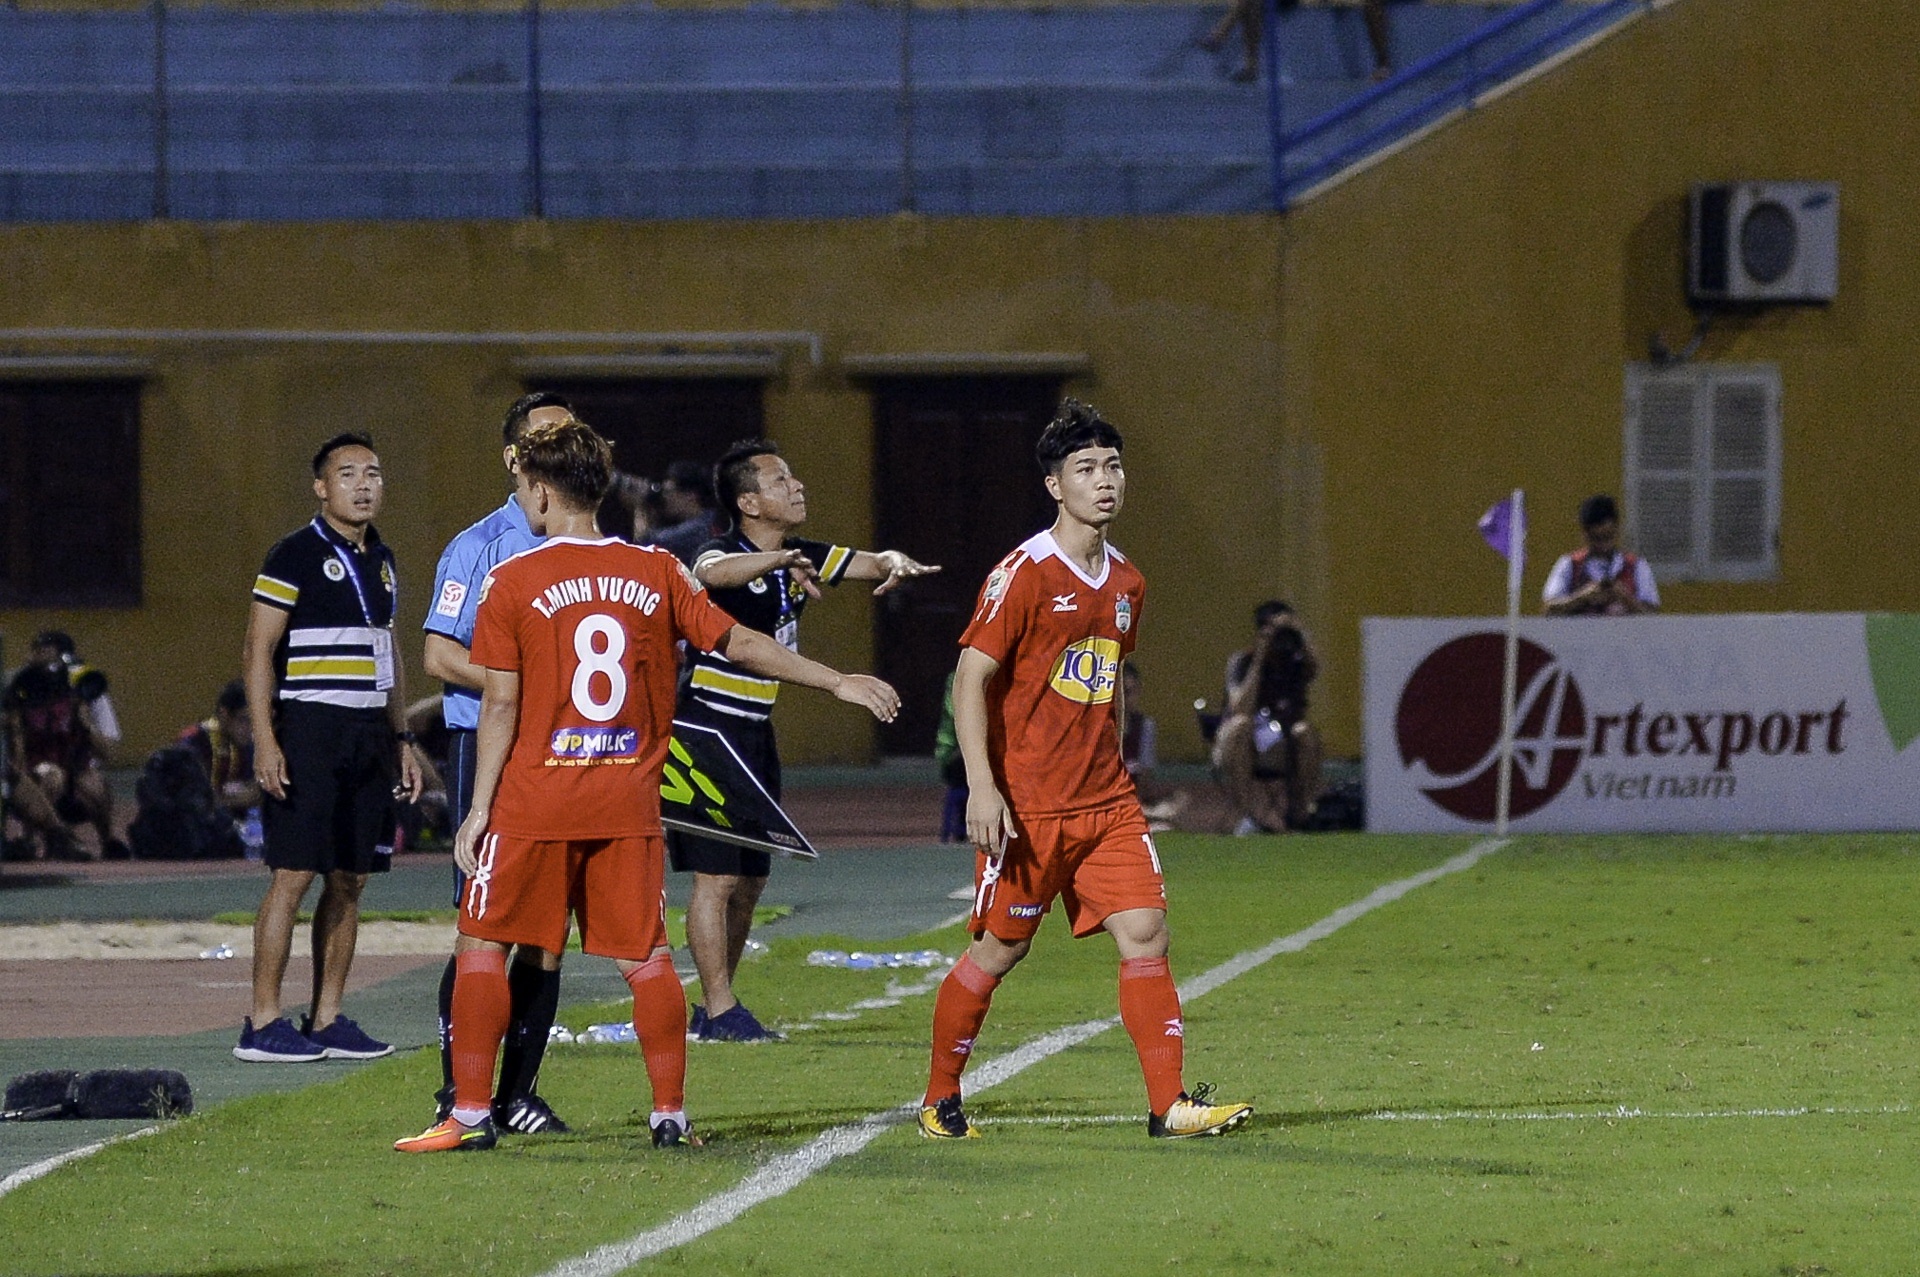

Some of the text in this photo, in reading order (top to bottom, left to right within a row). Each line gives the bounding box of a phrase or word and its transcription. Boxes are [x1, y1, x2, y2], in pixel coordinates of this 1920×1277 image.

[531, 576, 593, 620] T.MINH
[571, 613, 628, 722] 8
[1059, 649, 1098, 693] IQ
[1512, 662, 1850, 790] Artexport
[1581, 770, 1736, 800] Vietnam
